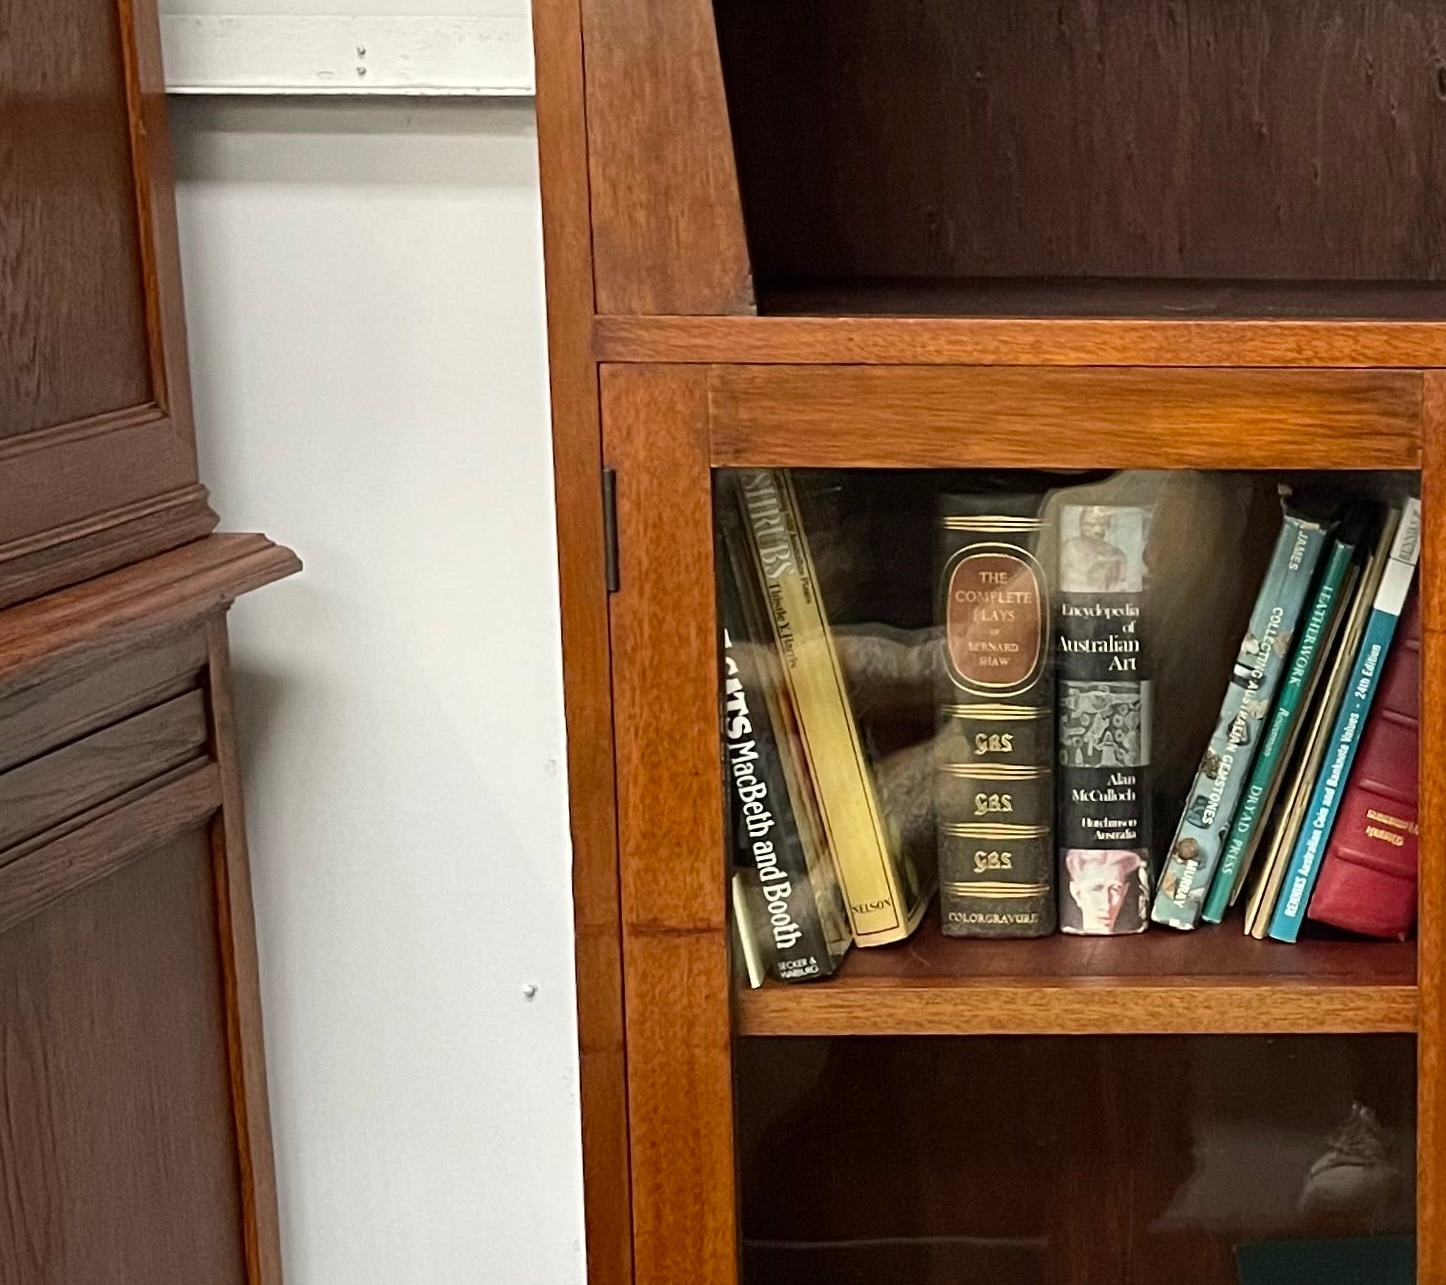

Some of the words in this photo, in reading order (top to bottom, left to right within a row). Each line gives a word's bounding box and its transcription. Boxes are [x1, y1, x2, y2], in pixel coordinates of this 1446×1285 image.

[744, 473, 795, 579] SHRUBS
[1289, 530, 1309, 571] JAMES
[978, 571, 1008, 584] THE
[955, 590, 1033, 604] COMPLETE
[973, 609, 1016, 622] PLAYS
[1062, 603, 1140, 619] Encyclopedia
[1122, 620, 1136, 633] of
[1288, 585, 1334, 687] LEATHERWORK
[968, 641, 1019, 653] BERNARD
[1060, 634, 1140, 653] Australian
[1249, 606, 1283, 679] COLLECTING
[978, 656, 1010, 667] SHAW
[1108, 655, 1137, 671] Art
[1362, 644, 1382, 678] Edition
[1354, 676, 1370, 700] 24th
[1228, 679, 1259, 752] AUSTRALIAN
[1340, 712, 1359, 744] Values
[974, 733, 1013, 755] GBS
[1326, 744, 1349, 788] Banknote
[729, 740, 775, 838] MacBeth
[1106, 772, 1136, 786] Alan
[1202, 753, 1235, 826] GEMSTONES
[974, 793, 1013, 815] GBS
[1072, 788, 1136, 802] McCulloch
[1322, 786, 1336, 808] and
[1238, 785, 1263, 833] DRYAD
[1313, 806, 1329, 831] Coin
[1081, 817, 1137, 828] Hutchinson
[1094, 828, 1137, 840] Australia
[753, 839, 780, 882] and
[973, 850, 1012, 873] GBS
[1222, 839, 1243, 875] PRESS
[1298, 830, 1322, 877] Australian
[1173, 860, 1199, 909] MURRAY
[763, 879, 802, 950] Booth
[851, 898, 892, 915] NELSON
[948, 912, 1038, 924] COLORGRAVURE
